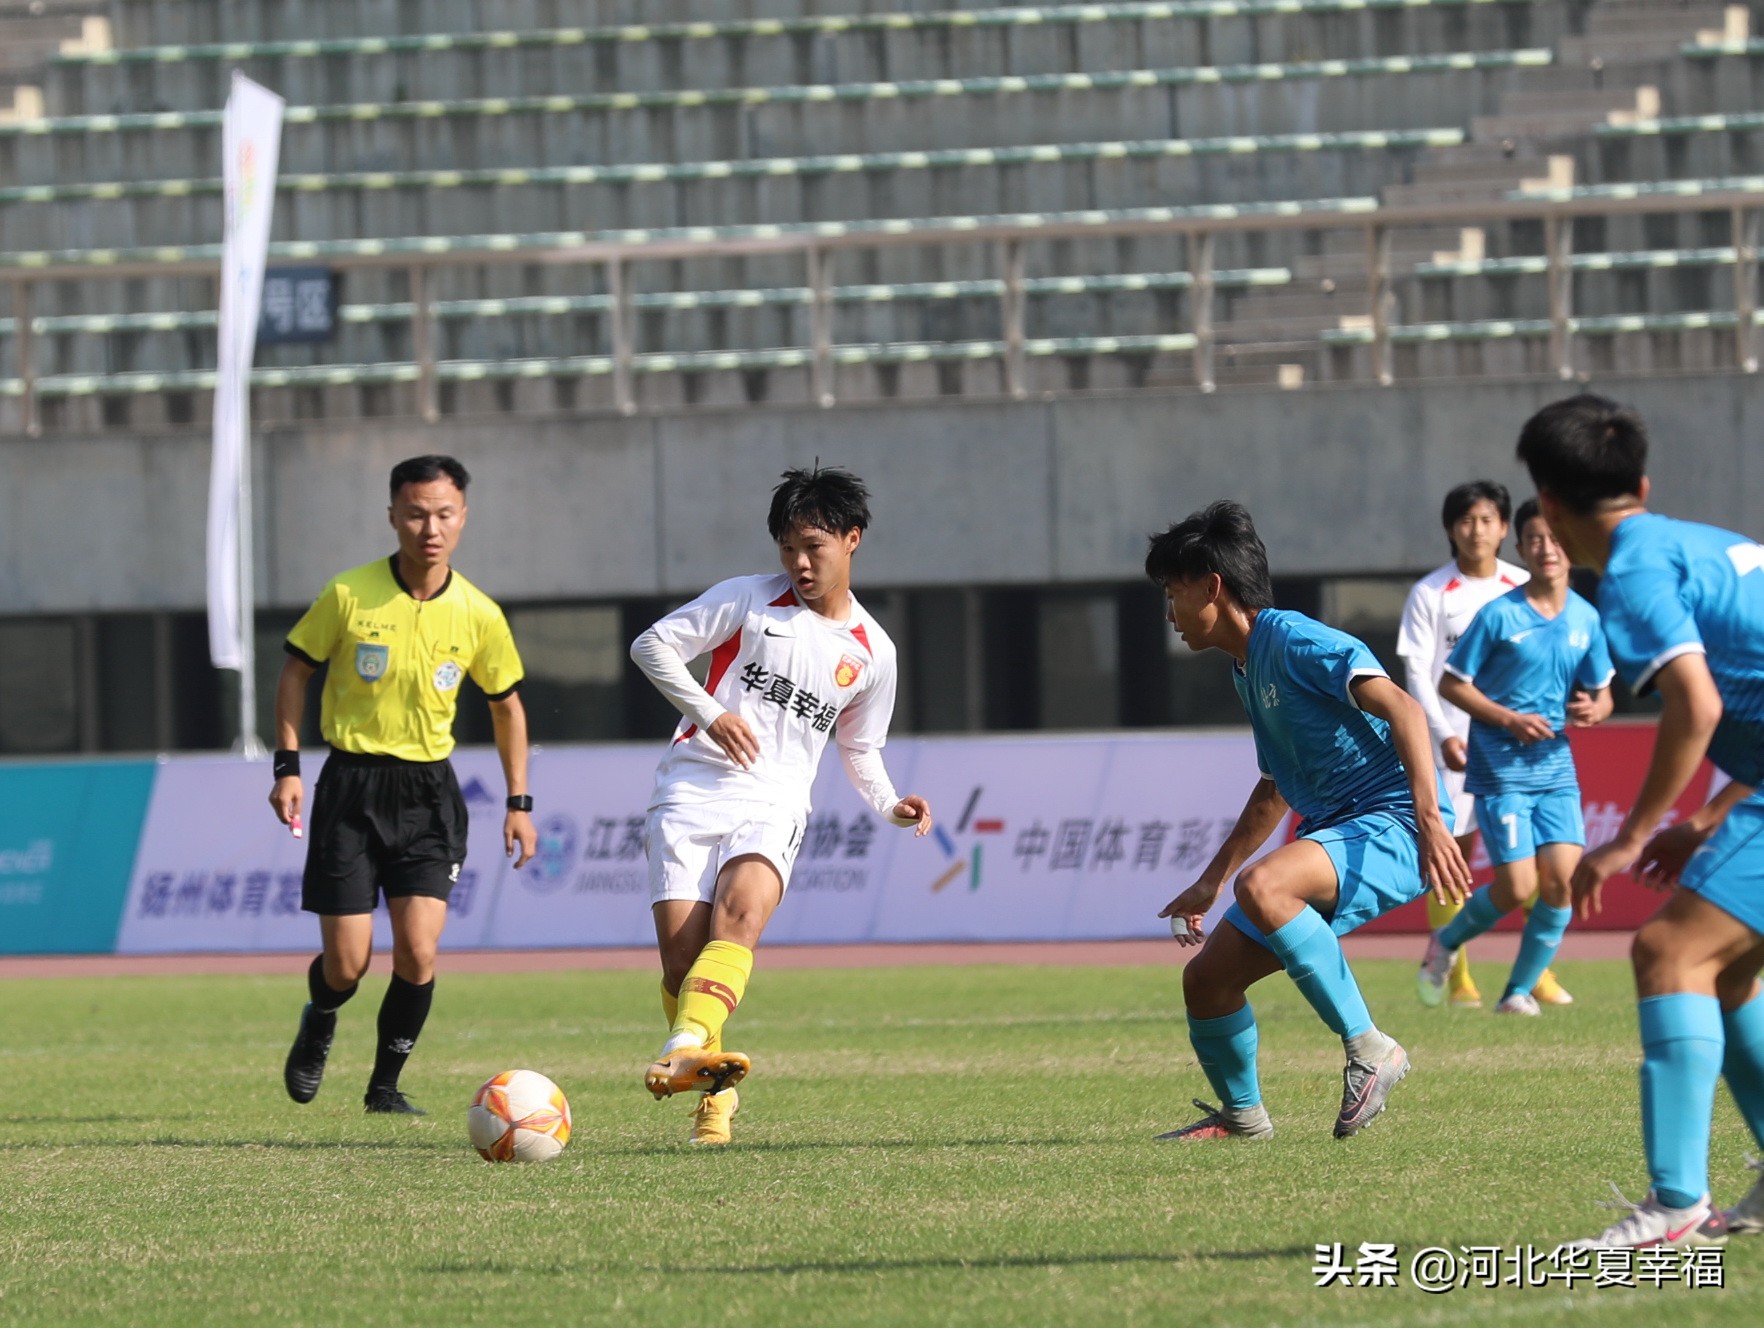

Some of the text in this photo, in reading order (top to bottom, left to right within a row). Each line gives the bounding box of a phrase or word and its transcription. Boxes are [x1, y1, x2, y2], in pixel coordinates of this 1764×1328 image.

[357, 620, 397, 631] KELME
[739, 661, 838, 733] 华夏幸福
